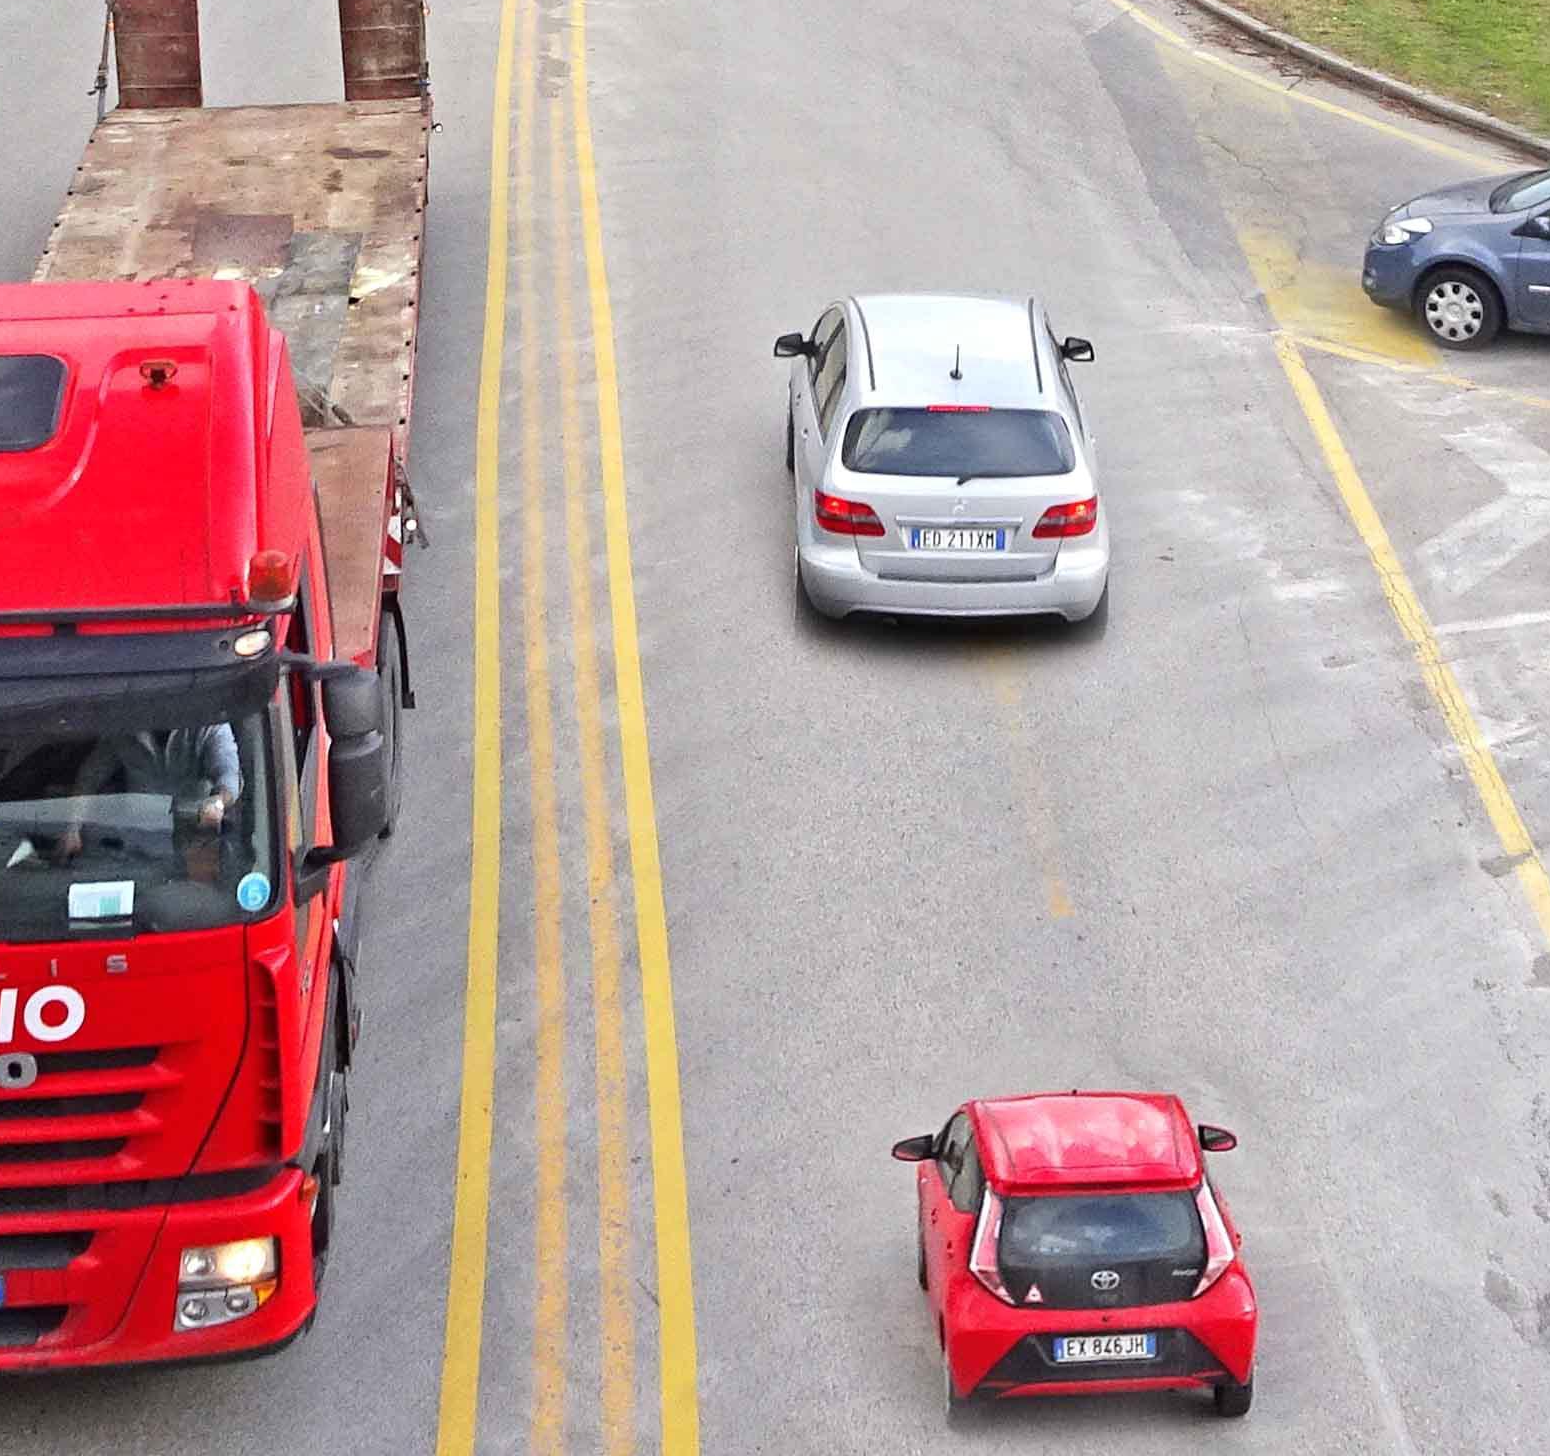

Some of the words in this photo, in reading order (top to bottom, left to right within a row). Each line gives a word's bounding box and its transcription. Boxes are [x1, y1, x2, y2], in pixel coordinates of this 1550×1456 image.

[923, 530, 942, 547] ED
[948, 530, 994, 548] 211XM
[1066, 1338, 1087, 1356] EX
